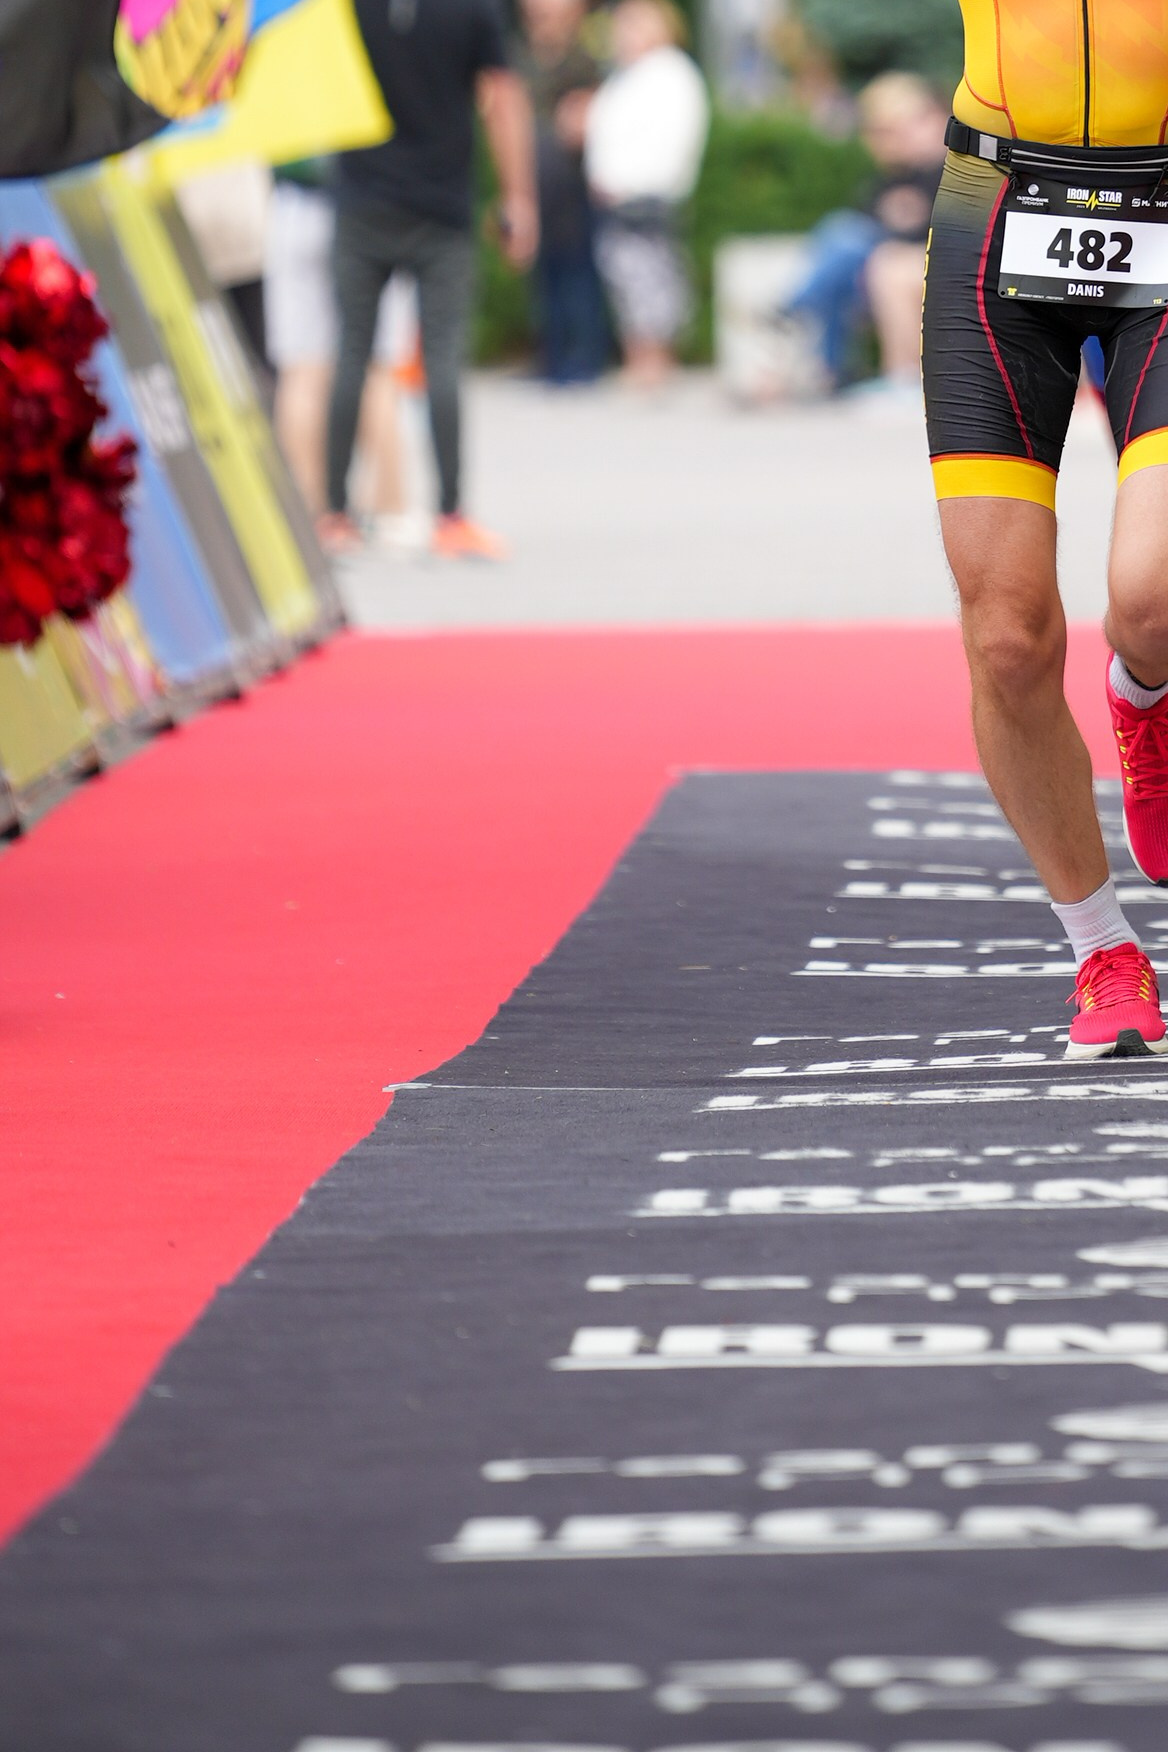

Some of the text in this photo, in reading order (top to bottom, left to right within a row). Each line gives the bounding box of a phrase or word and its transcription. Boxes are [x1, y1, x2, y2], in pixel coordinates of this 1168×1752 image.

[1066, 188, 1123, 203] IRON STAR
[1046, 227, 1133, 273] 482
[1067, 283, 1104, 298] DANIS
[455, 1502, 1157, 1554] IRON
